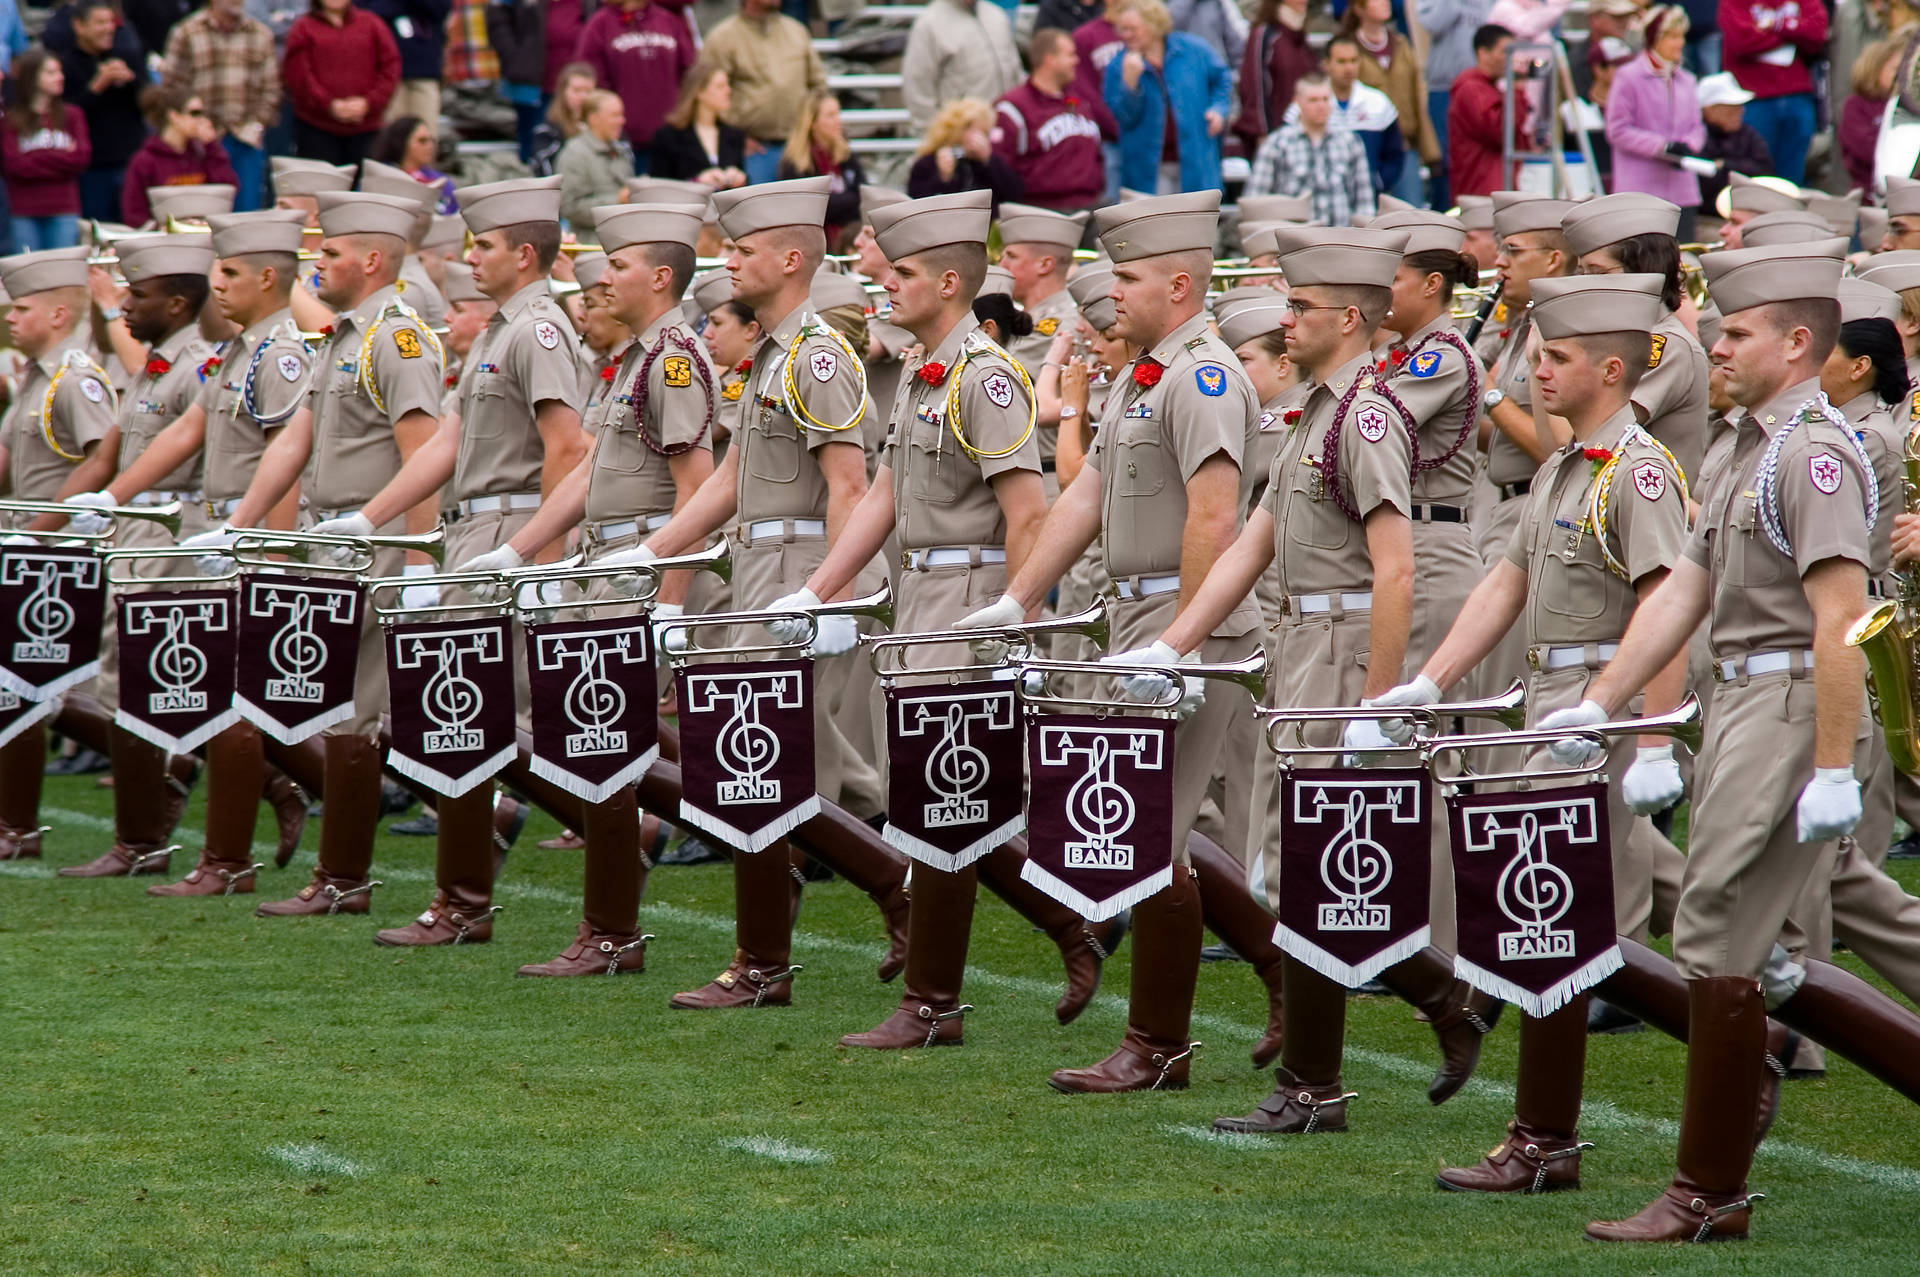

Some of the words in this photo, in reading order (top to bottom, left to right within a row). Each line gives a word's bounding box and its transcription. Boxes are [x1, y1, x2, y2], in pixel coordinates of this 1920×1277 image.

[272, 684, 318, 697] BAND
[156, 696, 202, 708] BAND
[430, 734, 478, 749] BAND
[572, 735, 621, 752] BAND
[724, 784, 775, 800] BAND
[931, 806, 982, 823] BAND
[1072, 848, 1127, 865] BAND
[1326, 910, 1383, 926] BAND
[1507, 937, 1567, 956] BAND
